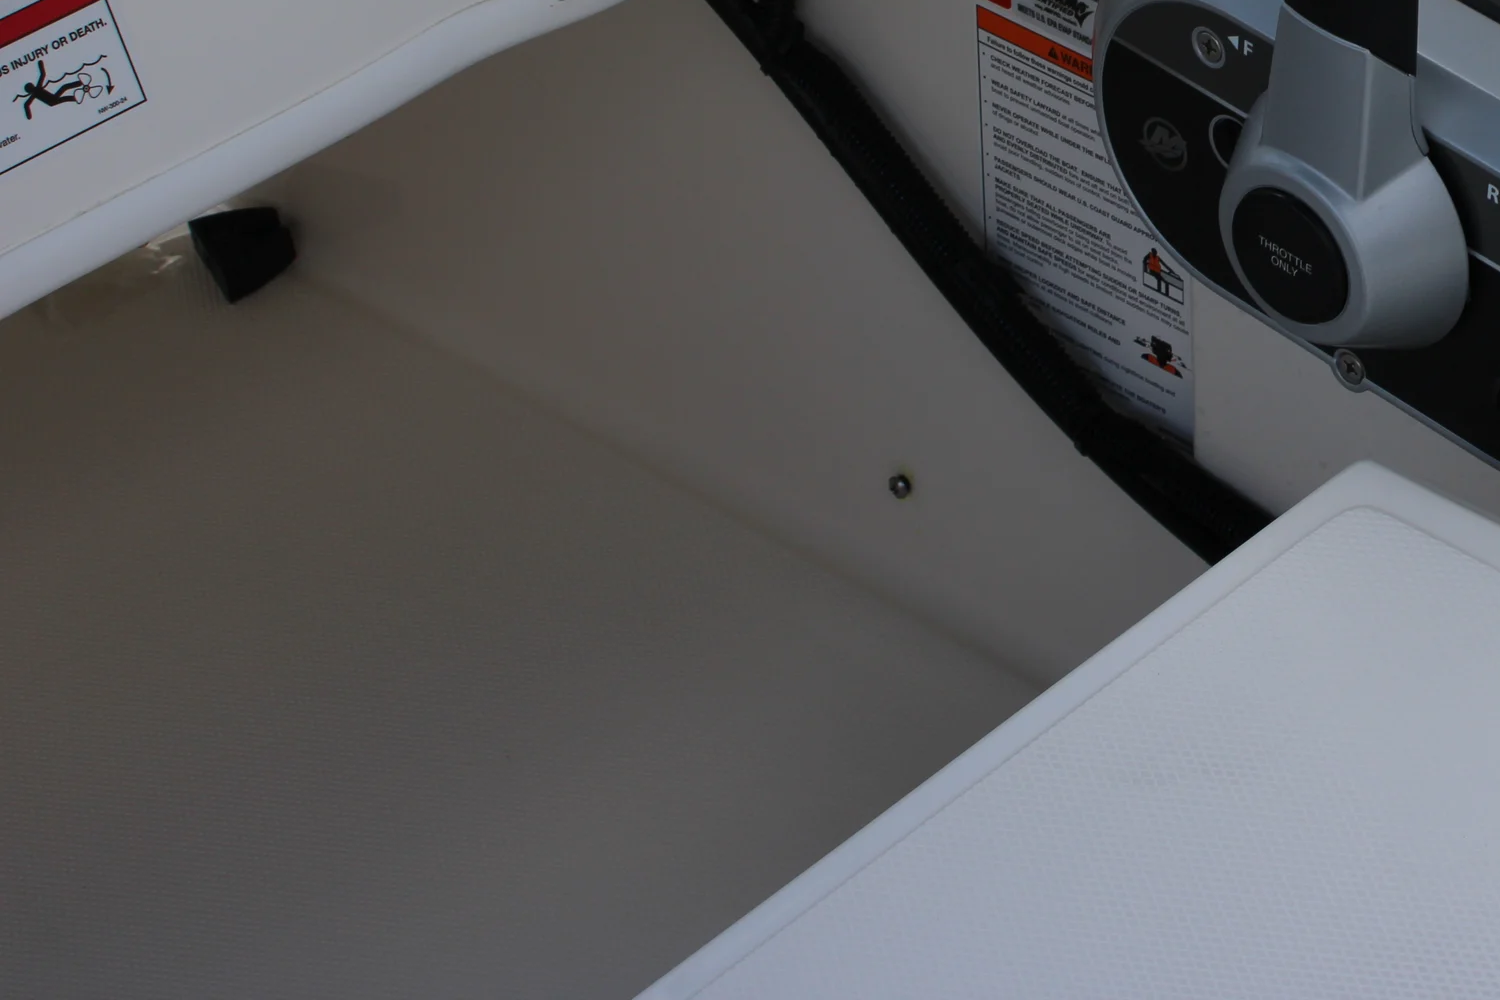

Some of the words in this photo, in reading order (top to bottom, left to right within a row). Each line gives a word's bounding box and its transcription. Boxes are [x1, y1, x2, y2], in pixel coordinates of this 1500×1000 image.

[11, 45, 49, 71] INJURY
[51, 36, 69, 50] OR
[69, 18, 108, 41] DEATH.
[1243, 39, 1253, 56] F
[1486, 183, 1499, 204] R
[1258, 234, 1312, 275] THROTTLE
[1270, 255, 1298, 277] ONLY
